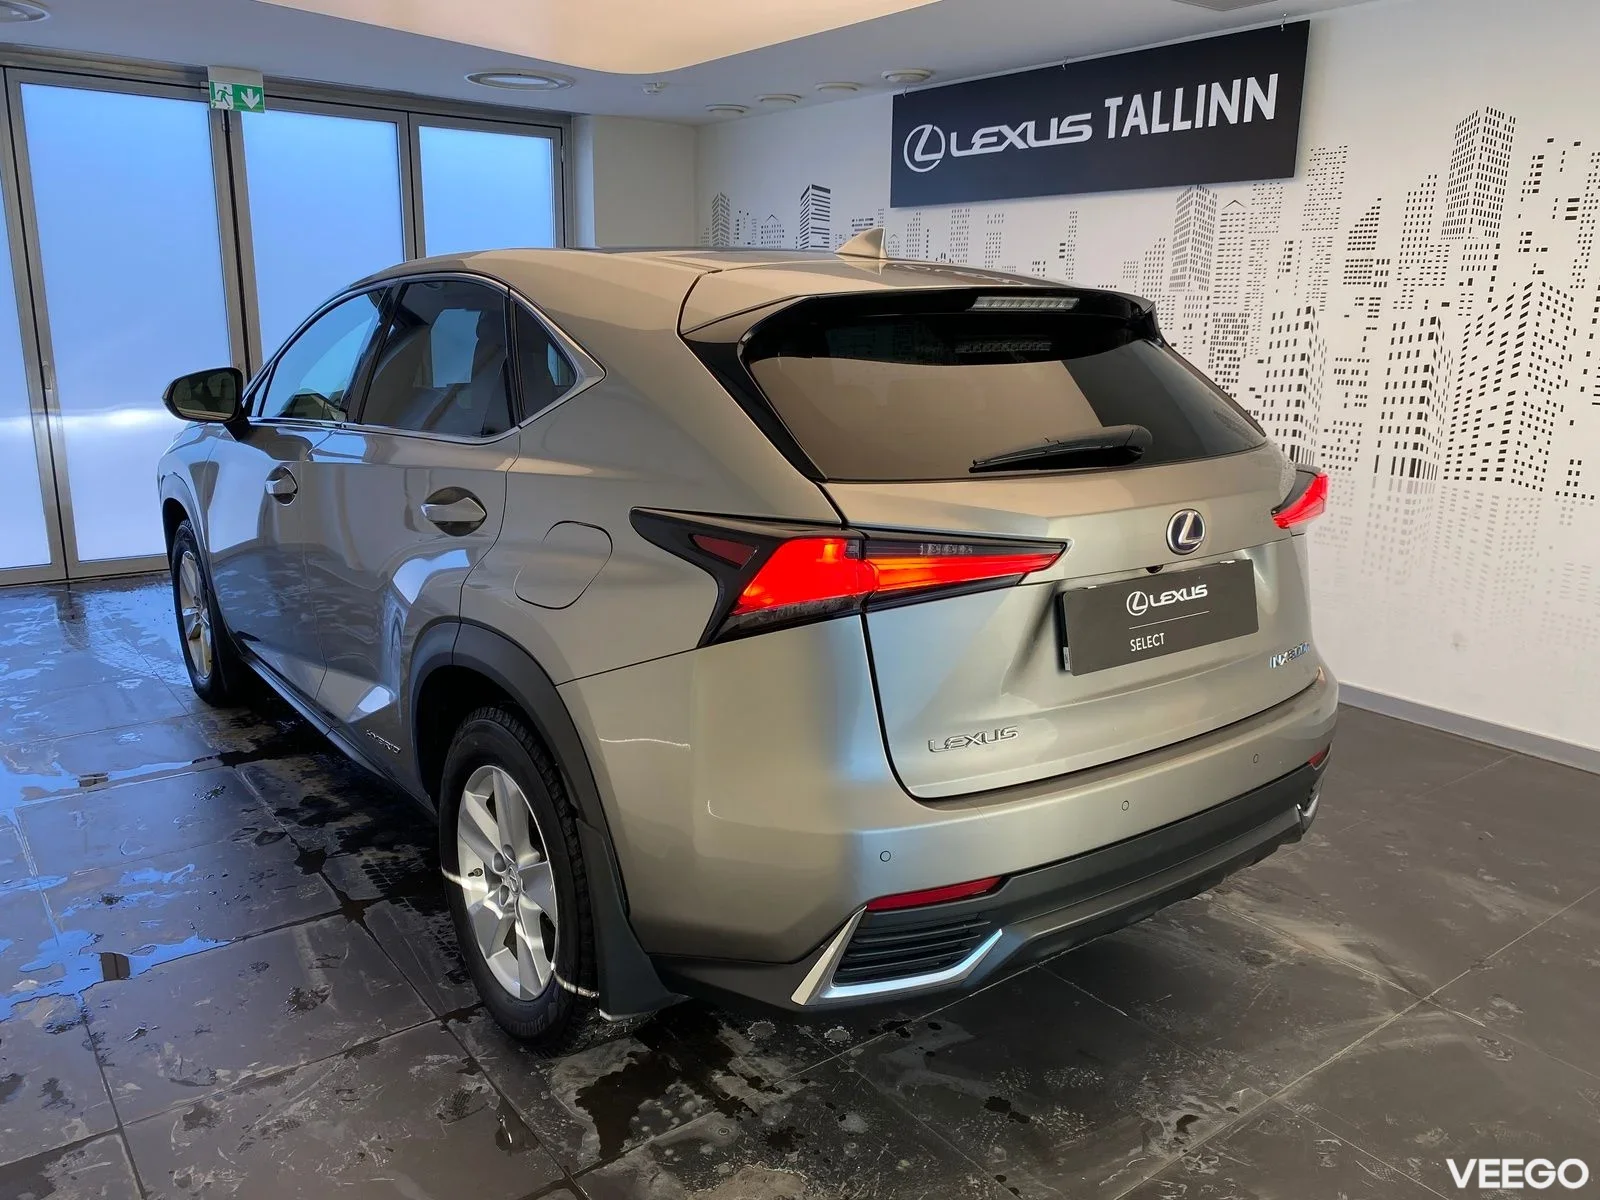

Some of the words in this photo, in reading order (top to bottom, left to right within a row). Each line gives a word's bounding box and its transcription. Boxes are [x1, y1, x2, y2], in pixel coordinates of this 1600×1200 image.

[950, 112, 1092, 157] LEXUS
[1104, 73, 1279, 140] TALLINN
[1150, 584, 1208, 607] LEXUS
[1130, 633, 1165, 652] SELECT
[928, 725, 1019, 753] LEXUS
